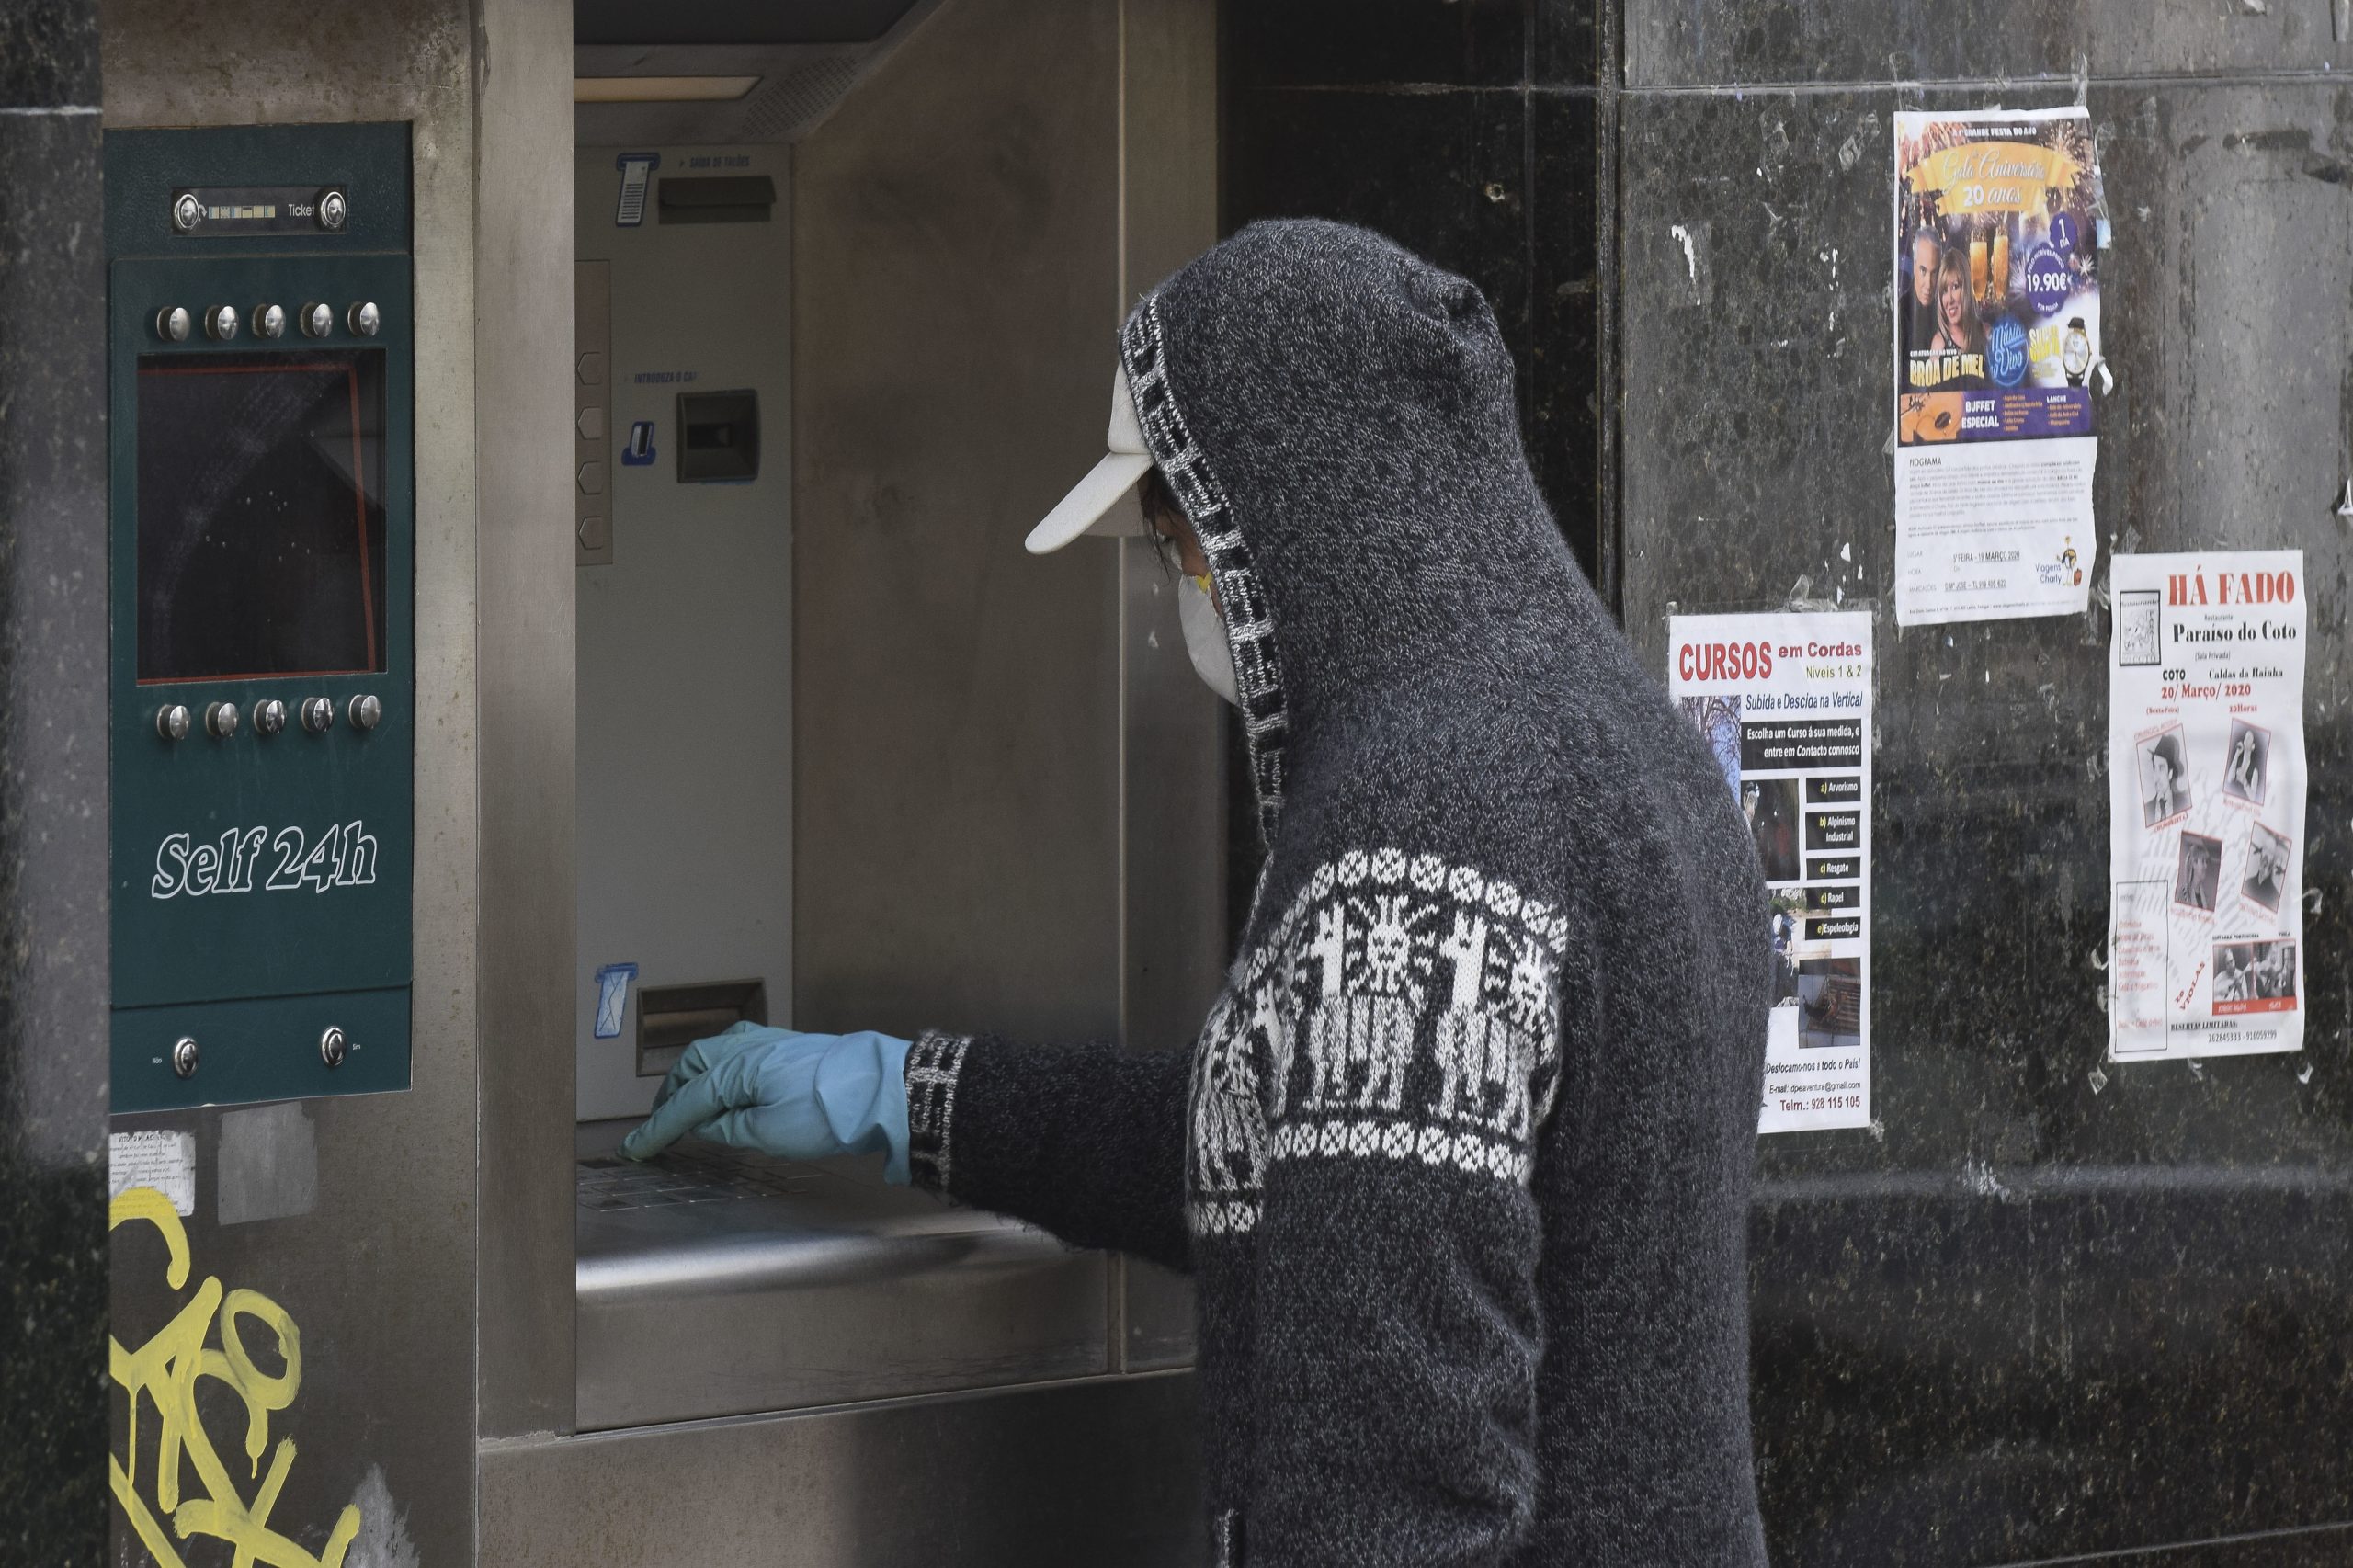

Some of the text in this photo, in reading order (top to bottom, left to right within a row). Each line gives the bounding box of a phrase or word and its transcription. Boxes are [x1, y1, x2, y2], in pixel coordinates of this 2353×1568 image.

[1990, 127, 2013, 137] FESTA
[2024, 126, 2038, 136] ANO
[1963, 185, 2022, 207] 20 anos
[288, 203, 315, 217] Ticket
[2058, 218, 2066, 239] 1
[2027, 272, 2067, 292] 19.90€
[1910, 353, 1985, 387] BROA DE MEL
[1965, 400, 1996, 413] BUFFET
[1961, 415, 2000, 429] ESPECIAL
[1985, 551, 2007, 562] MARÇO
[2035, 563, 2062, 574] Viagens
[2040, 574, 2062, 584] Charly
[2167, 565, 2295, 606] HÁ FADO
[2173, 620, 2297, 642] Paraíso do Coto
[1679, 642, 1862, 681] CURSOS em Cordas
[1838, 665, 1843, 677] 1
[1847, 665, 1854, 677] &
[1857, 665, 1862, 676] 2
[2162, 666, 2283, 681] COTO Caldas da Rainha
[2162, 684, 2179, 702] 20/
[2224, 683, 2251, 696] 2020
[1745, 691, 1863, 710] Subida e Descida na Vertical
[1747, 726, 1860, 740] Escolha um Curso á sua medida, e
[1764, 744, 1859, 758] entre em Contacto connosco
[1820, 782, 1858, 793] a) Arvorismo
[1819, 815, 1856, 828] b) Alpinismo
[1826, 831, 1853, 842] Industrial
[151, 820, 378, 899] Self 24h
[1820, 862, 1849, 875] c) Resgate
[1821, 892, 1844, 904] d) Rapel
[2180, 961, 2205, 1010] VIOLAS
[1766, 1062, 1815, 1074] Deslocamo-nos
[1822, 1058, 1837, 1070] todo
[1769, 1085, 1790, 1094] E-mail:
[1780, 1096, 1860, 1111] Telm.: 928 115 105
